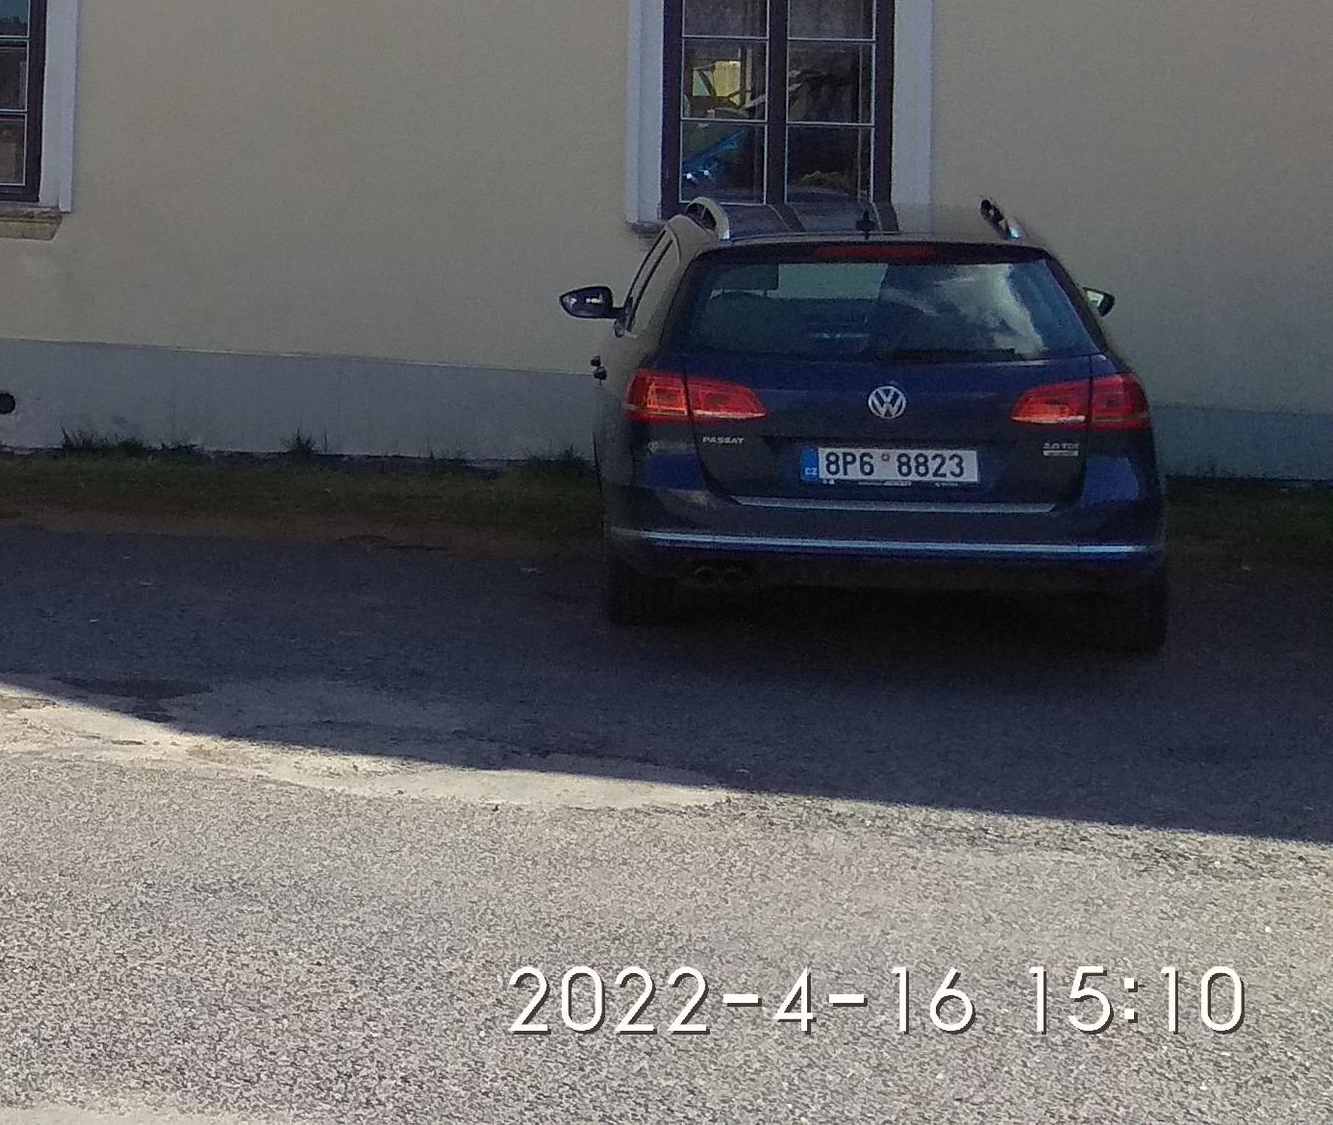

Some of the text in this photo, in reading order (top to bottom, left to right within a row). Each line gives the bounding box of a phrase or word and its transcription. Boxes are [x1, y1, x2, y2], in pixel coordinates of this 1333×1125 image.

[702, 436, 744, 444] PASSAT
[825, 451, 965, 478] 8P6 8823
[804, 466, 818, 476] CZ
